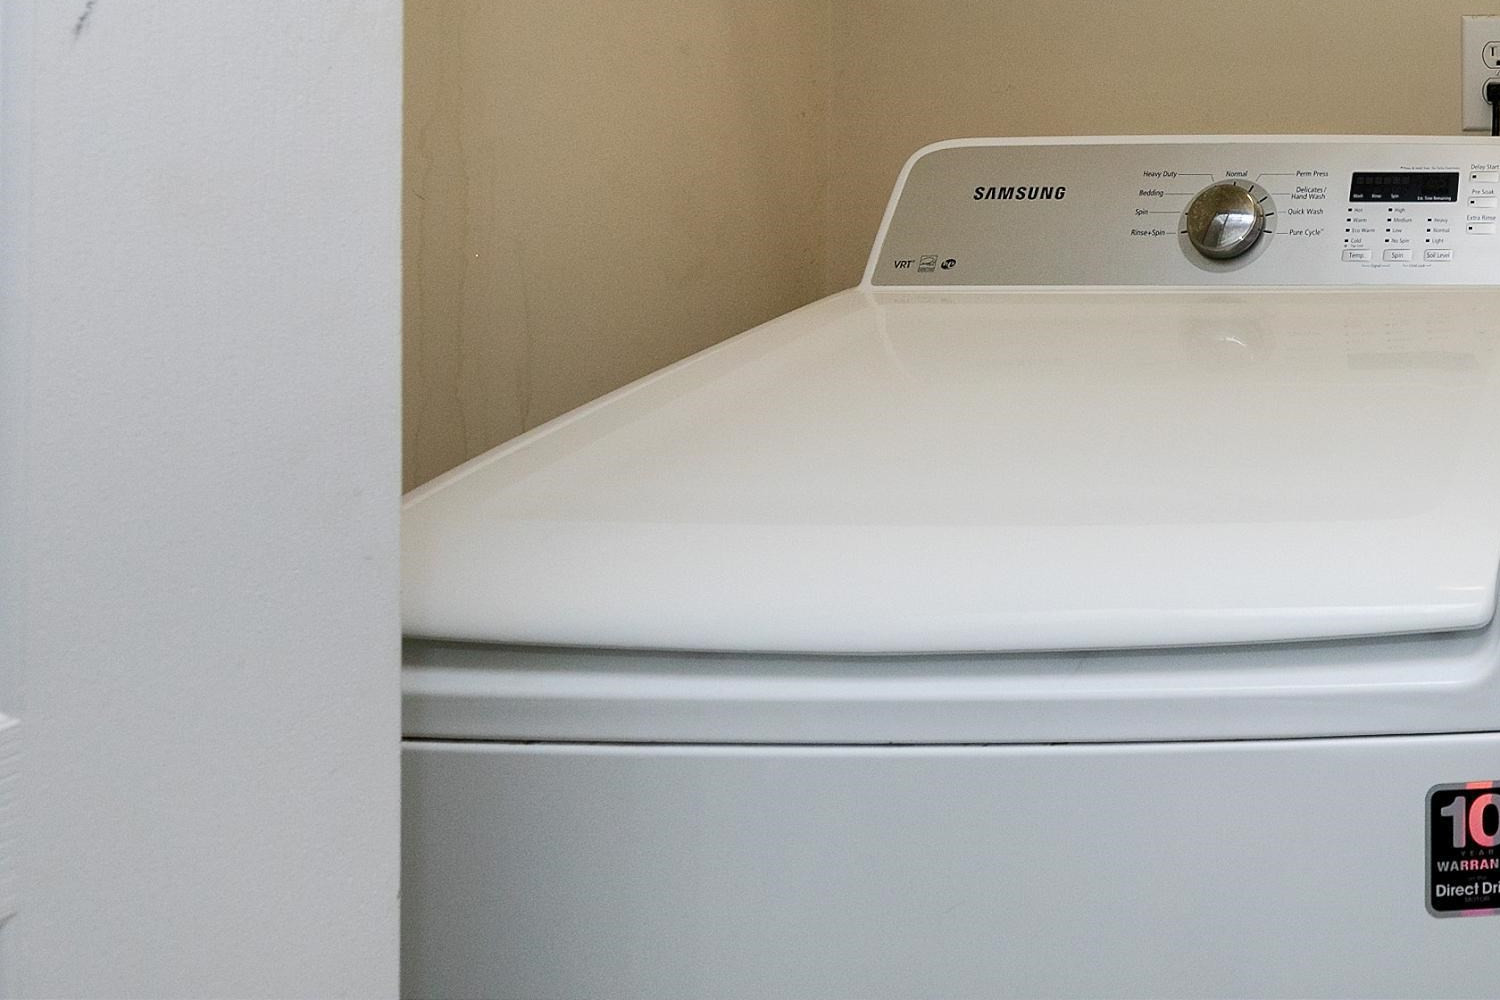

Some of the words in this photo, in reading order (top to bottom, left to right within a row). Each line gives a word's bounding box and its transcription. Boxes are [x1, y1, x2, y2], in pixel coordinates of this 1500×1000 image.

[1143, 170, 1162, 178] Heavy
[1163, 170, 1177, 178] Duty
[973, 186, 1066, 200] SAMSUNG
[1138, 189, 1164, 198] Bedding
[1296, 186, 1322, 194] Delicates
[1135, 208, 1149, 216] Spin
[1288, 208, 1305, 216] Quick
[1436, 882, 1479, 897] Direct
